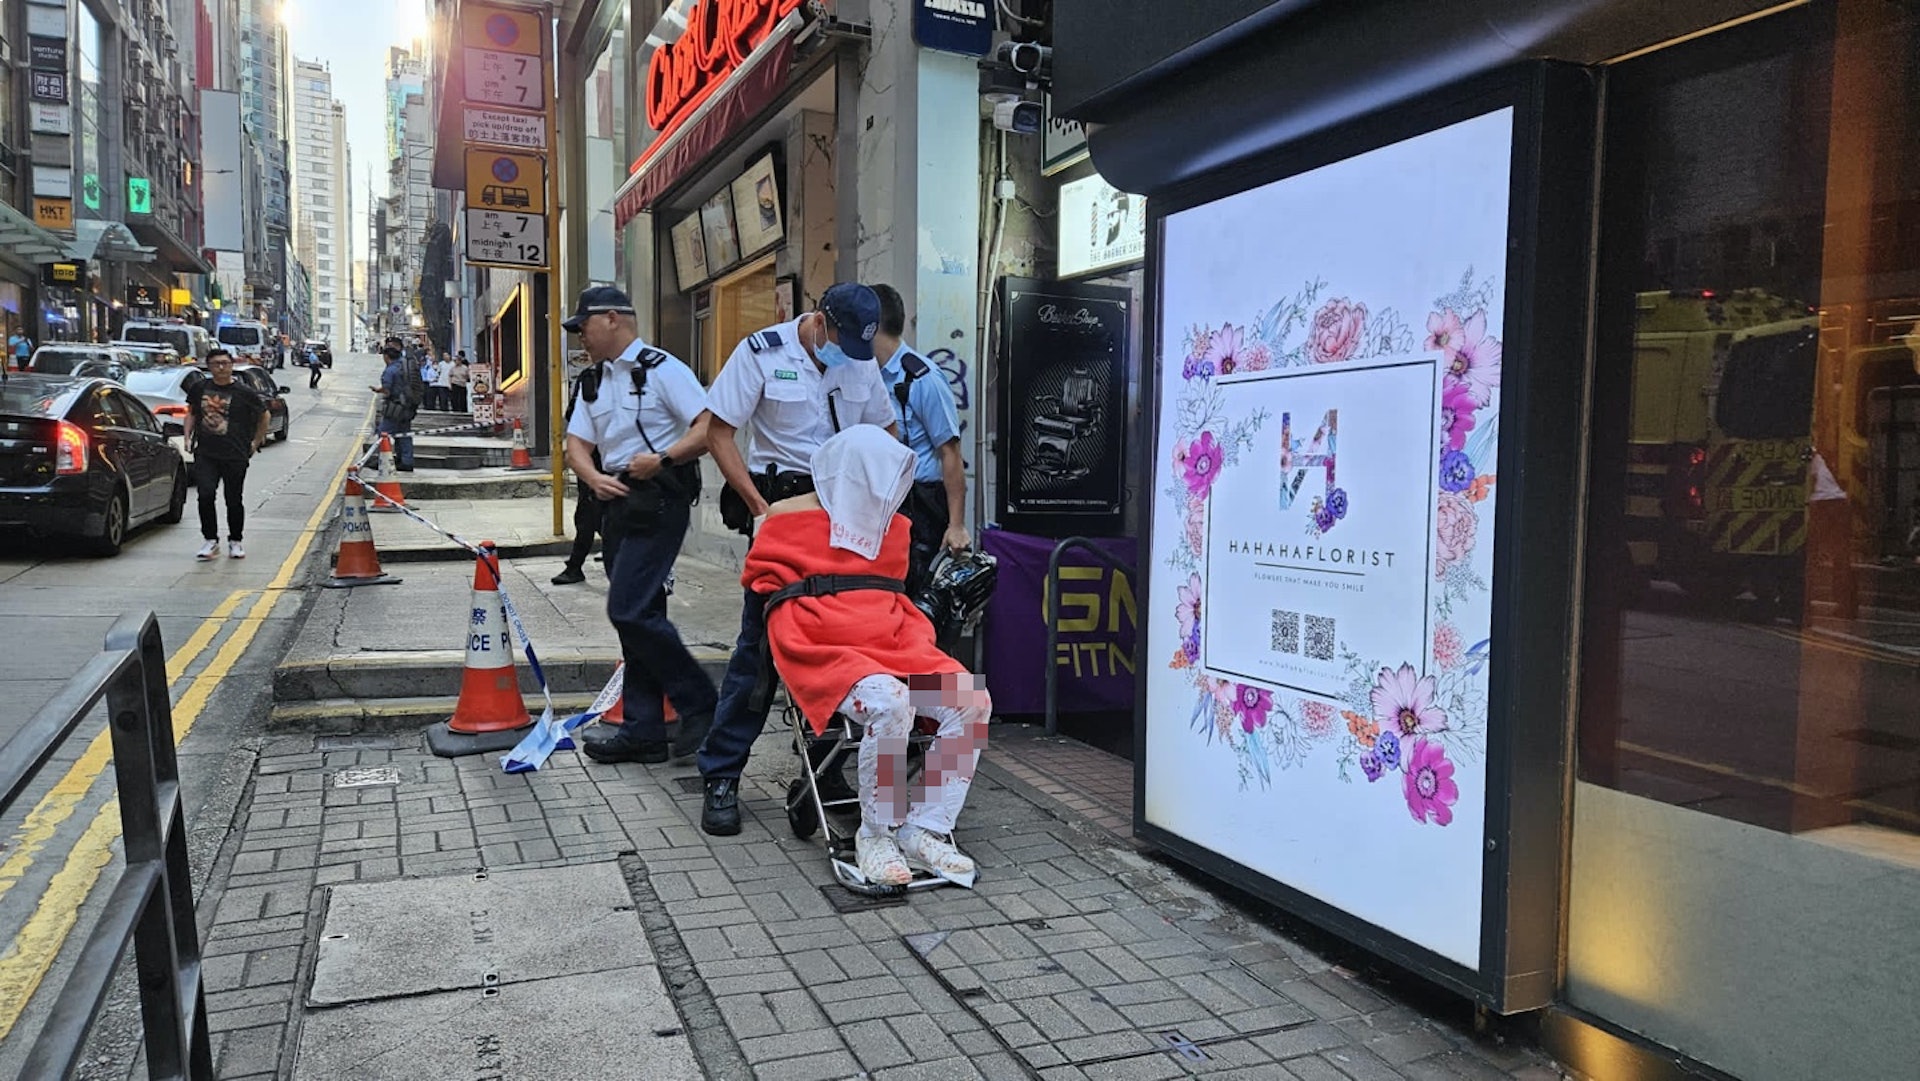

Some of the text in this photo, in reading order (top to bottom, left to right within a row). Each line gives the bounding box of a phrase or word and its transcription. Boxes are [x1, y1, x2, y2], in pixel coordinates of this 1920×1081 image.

[514, 58, 527, 75] 7
[515, 85, 528, 102] 7
[482, 112, 528, 124] Except taxi
[472, 121, 537, 134] pick up/drop off
[39, 204, 65, 216] HKT
[481, 220, 503, 230] 上午
[516, 216, 528, 233] 7
[471, 239, 512, 249] midnight
[481, 248, 504, 259] 午夜
[517, 244, 540, 261] 12
[1228, 540, 1396, 568] HAHAHAFLORIST
[1284, 576, 1301, 585] THAT
[1302, 578, 1321, 588] MAKE
[1324, 580, 1339, 590] YOU
[1341, 582, 1365, 593] SMILE
